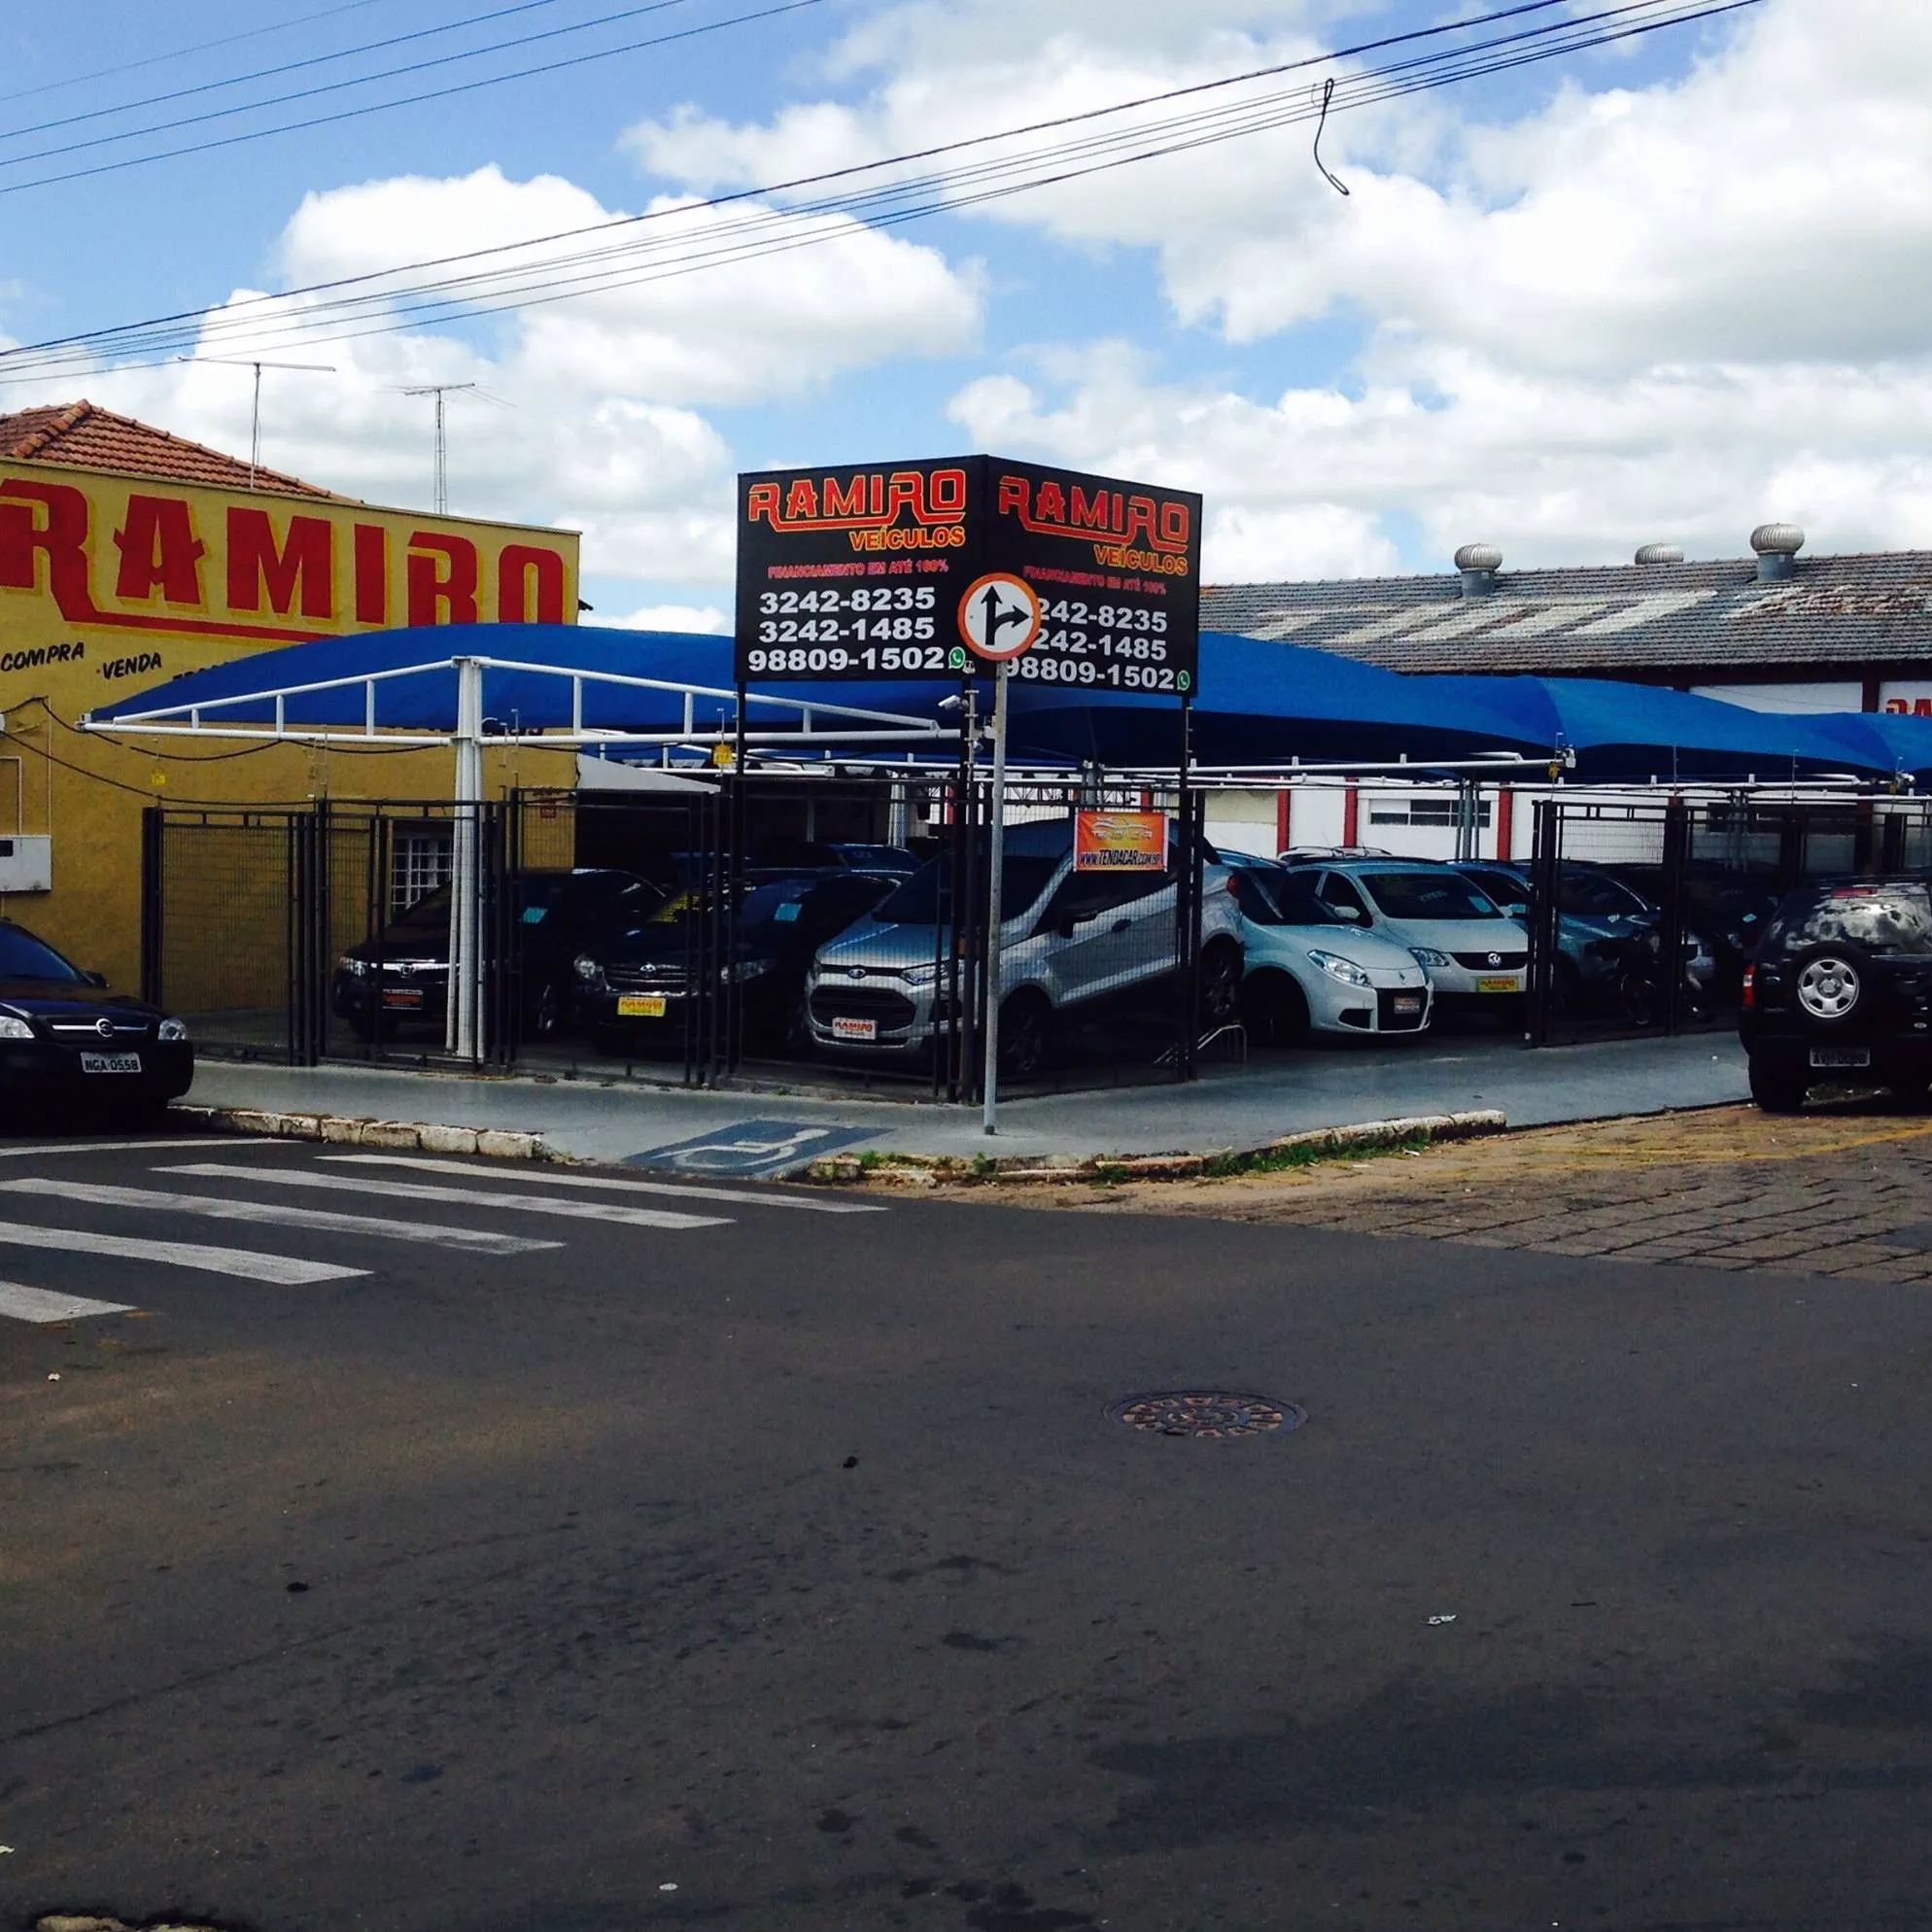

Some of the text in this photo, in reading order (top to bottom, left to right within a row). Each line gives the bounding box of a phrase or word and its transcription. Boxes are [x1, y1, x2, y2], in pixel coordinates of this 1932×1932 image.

[748, 468, 967, 533] RAMIRO
[998, 475, 1190, 554] RAMIRO
[849, 526, 966, 552] VEÍCULOS
[0, 477, 567, 637] RAMIRO
[768, 563, 865, 579] FINANCIAMENTO
[888, 559, 913, 574] ATÉ
[1093, 544, 1190, 576] VEÍCULOS
[760, 587, 936, 615] 3242-8235
[1039, 598, 1167, 633] 242-8235
[759, 617, 935, 643] 3242-1485
[1032, 628, 1167, 661] 242-1485
[1, 641, 85, 672] COMPRA
[102, 652, 162, 680] VENDA
[747, 646, 946, 673] 98809-1502
[1007, 656, 1175, 690] 98809-1502
